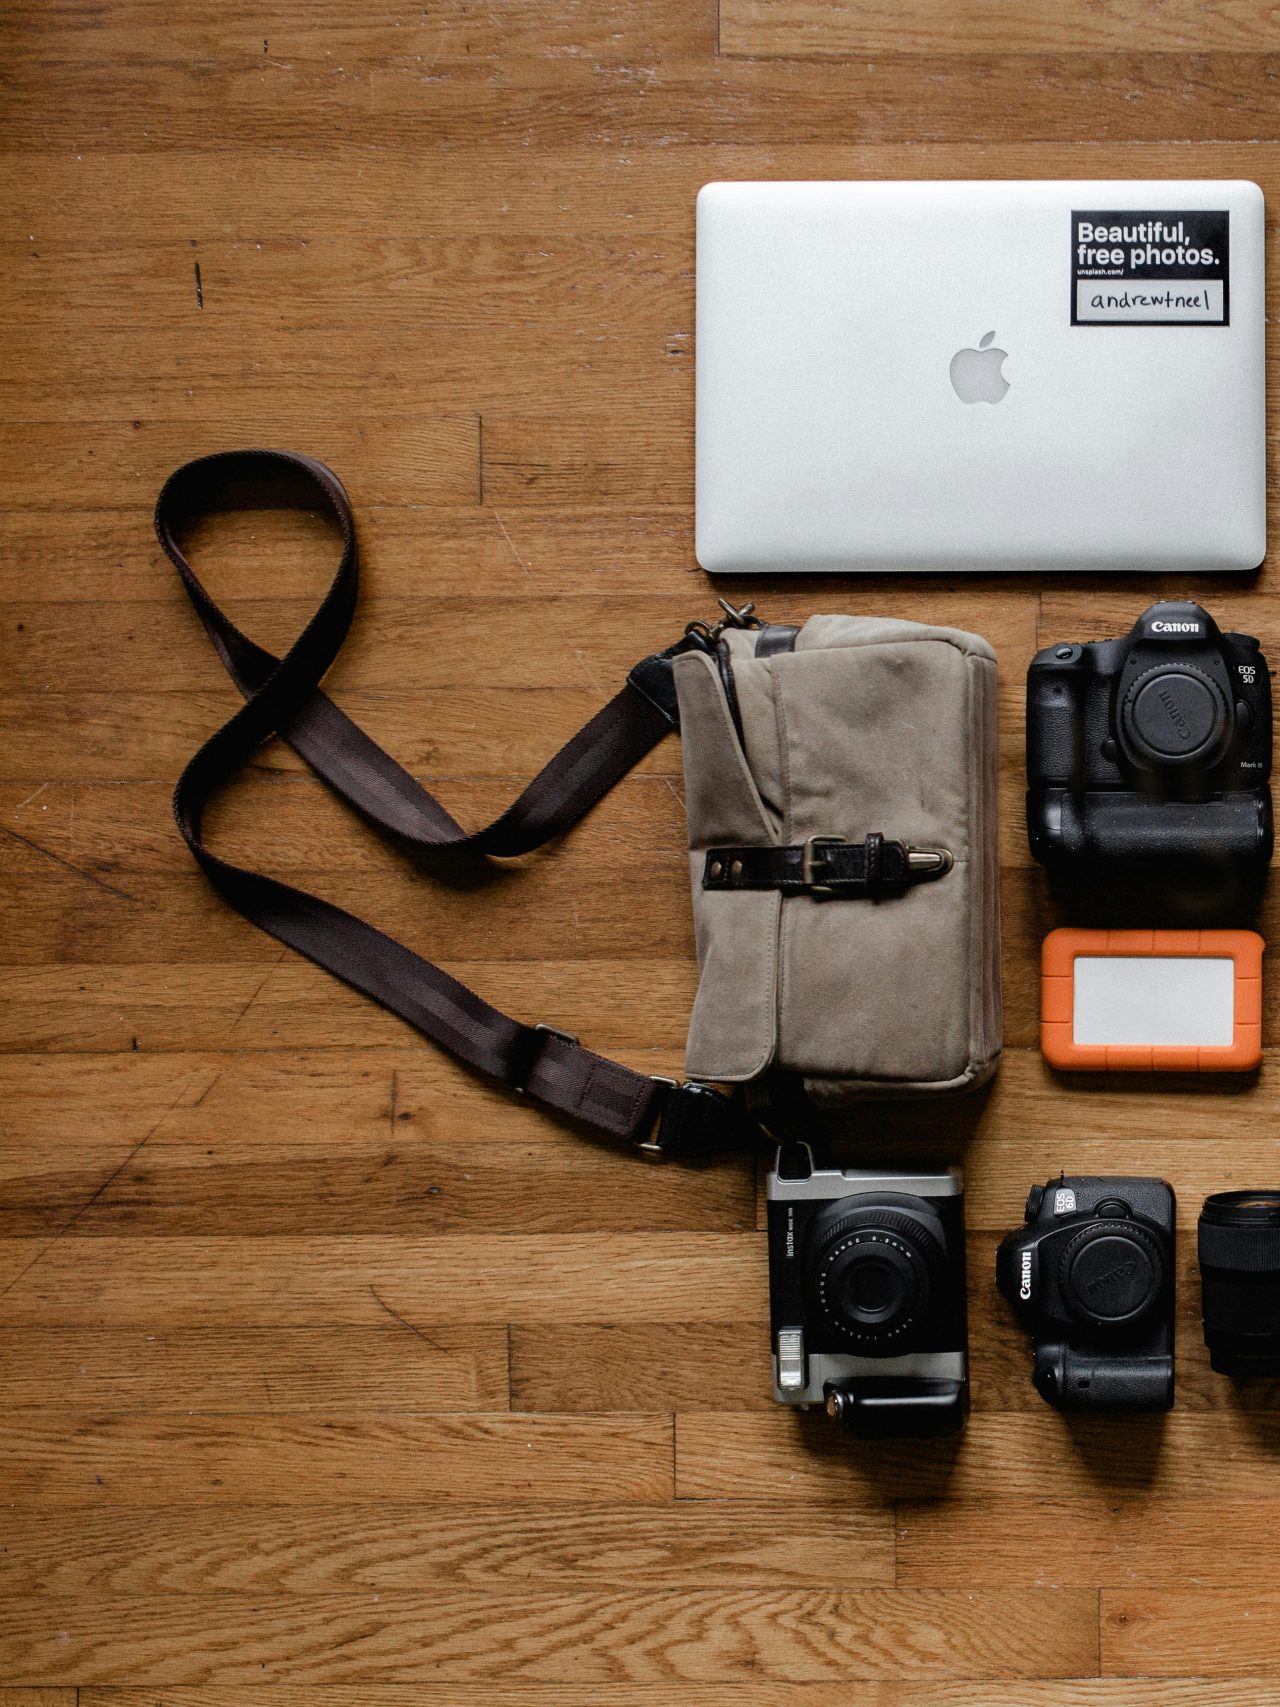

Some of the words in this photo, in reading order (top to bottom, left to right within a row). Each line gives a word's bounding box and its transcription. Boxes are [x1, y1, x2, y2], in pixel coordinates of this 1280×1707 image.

[1077, 221, 1191, 246] Beautiful,
[1077, 244, 1125, 265] free
[1130, 243, 1220, 269] photos.
[1076, 268, 1124, 276] unsplash.com/
[1091, 290, 1210, 310] andrewtneel
[1151, 621, 1199, 633] Canon
[1238, 665, 1256, 675] EOS
[1242, 675, 1254, 684] 5D
[1240, 761, 1256, 769] Mark
[1056, 1193, 1065, 1213] EOS
[1066, 1196, 1074, 1209] 6D
[786, 1231, 794, 1257] instax
[1019, 1251, 1032, 1300] Canon
